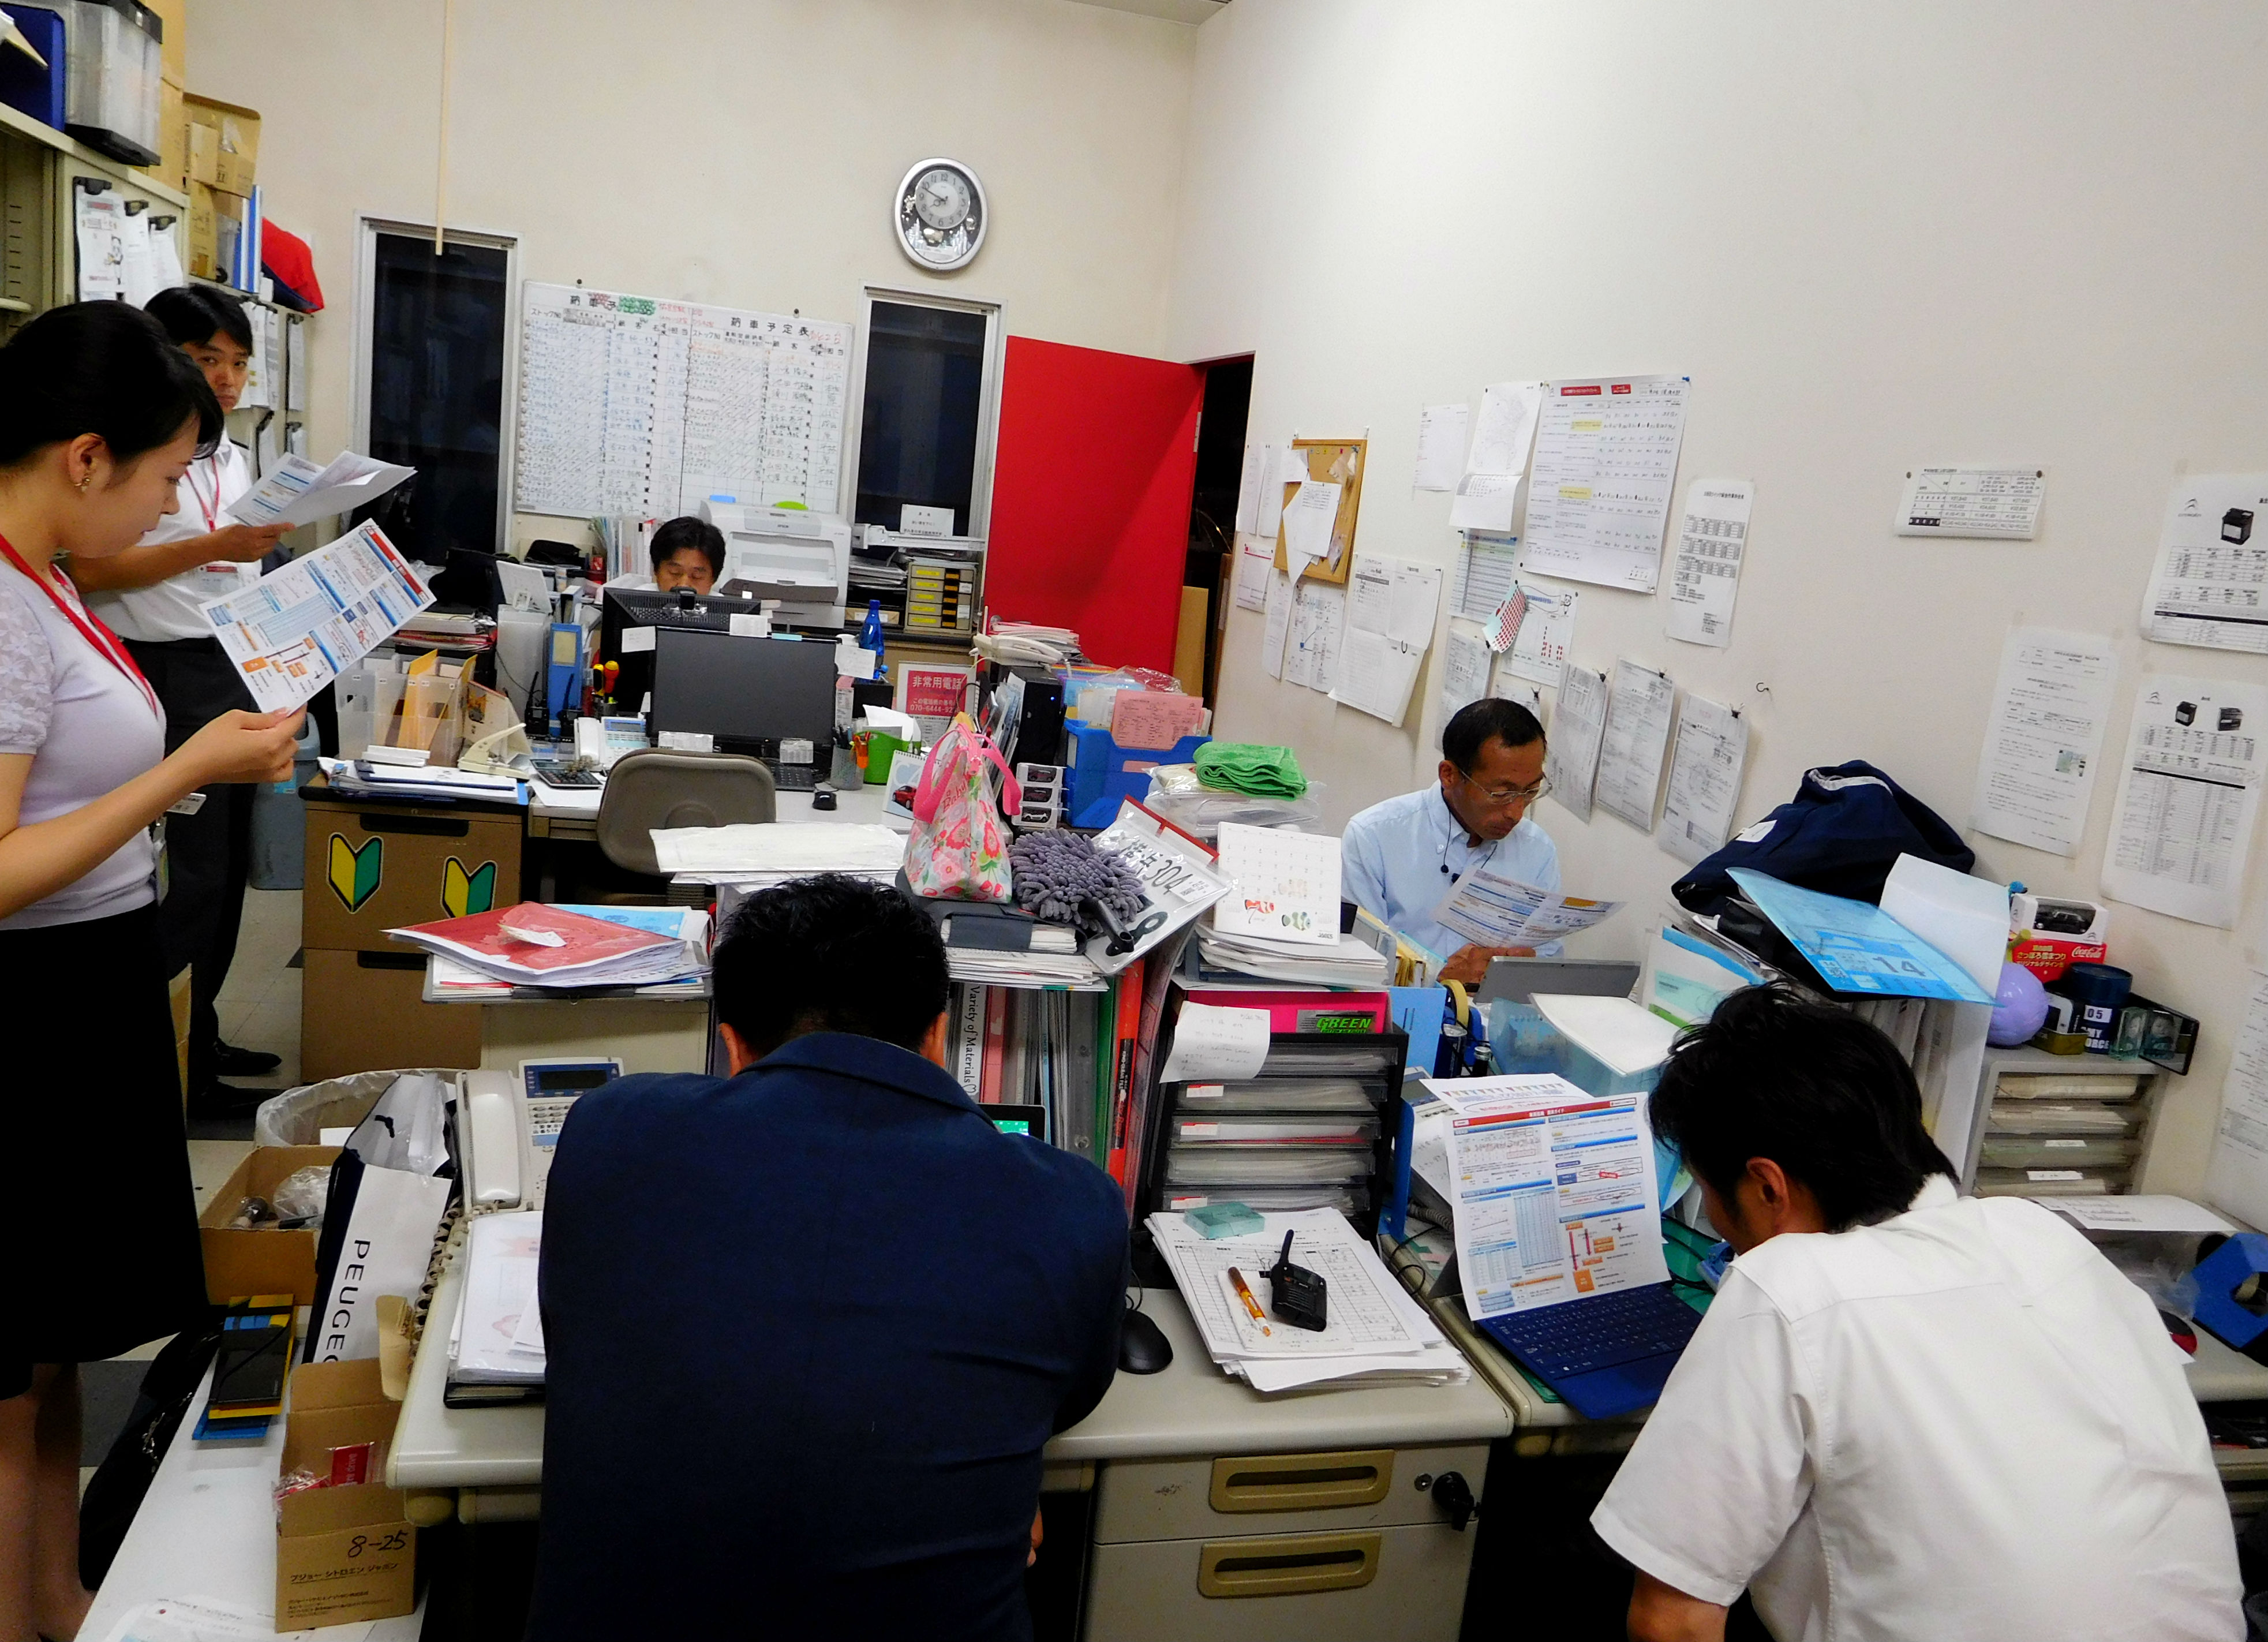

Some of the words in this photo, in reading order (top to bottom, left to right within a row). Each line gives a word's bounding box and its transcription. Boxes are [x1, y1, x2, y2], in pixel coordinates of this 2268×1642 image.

[912, 675, 962, 690] 非常用電話
[910, 704, 959, 713] 070-6444-92
[1142, 859, 1193, 895] 304
[964, 985, 980, 1022] Variety
[2087, 1008, 2104, 1019] 05
[964, 1024, 978, 1036] of
[1316, 1017, 1372, 1030] GREEN
[963, 1037, 977, 1083] Materials
[347, 1529, 409, 1558] 8-25
[290, 1573, 322, 1583] プジョー
[325, 1566, 365, 1578] シトロエン
